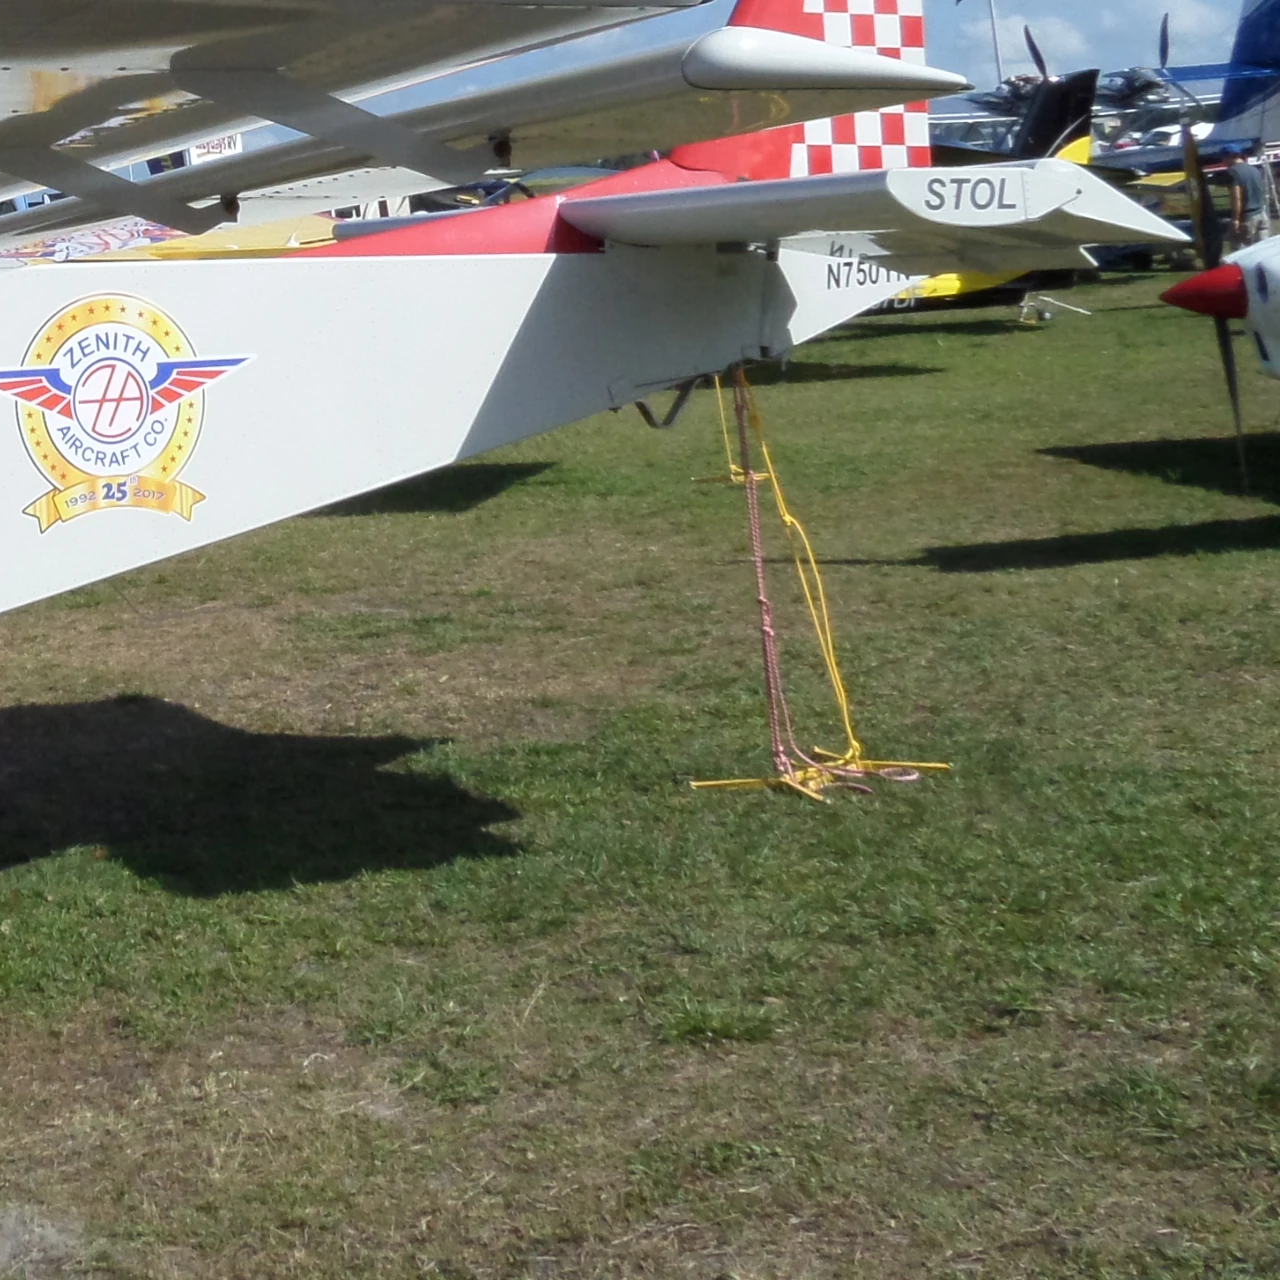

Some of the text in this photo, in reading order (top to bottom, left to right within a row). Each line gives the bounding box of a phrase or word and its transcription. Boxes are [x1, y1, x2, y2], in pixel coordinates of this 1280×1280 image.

[924, 177, 1017, 211] STOL
[826, 260, 910, 290] N750
[63, 332, 151, 370] ZENITH
[56, 423, 143, 469] AIRCRAFT
[64, 491, 97, 509] 1992
[133, 488, 165, 501] 2017
